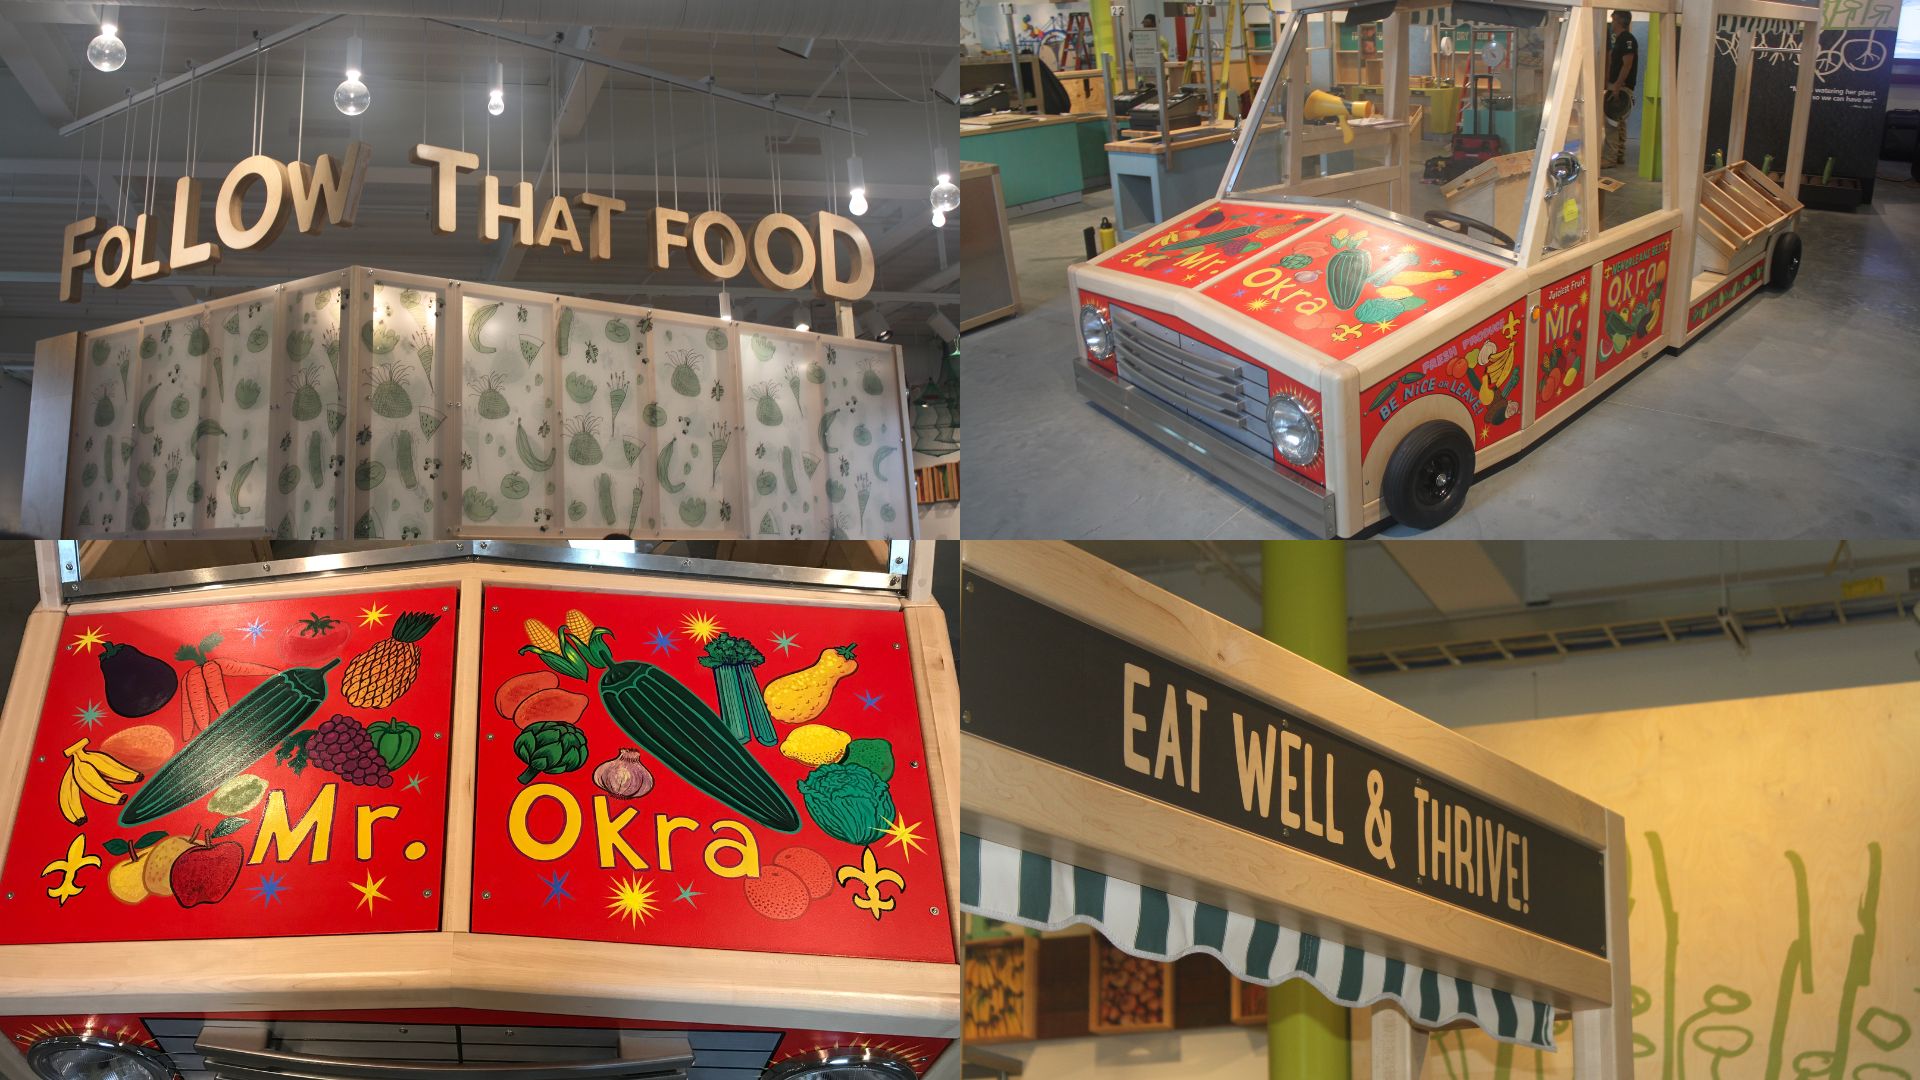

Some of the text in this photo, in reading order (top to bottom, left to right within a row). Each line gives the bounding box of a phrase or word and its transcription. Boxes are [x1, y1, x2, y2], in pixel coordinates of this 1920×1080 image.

[60, 141, 876, 303] FOLLOW THAT FOOD
[1172, 250, 1227, 275] Mr.
[1548, 275, 1586, 301] Juiciest Fruit
[1242, 266, 1328, 316] Okra
[1422, 317, 1505, 375] FRESH PRODUCE
[1545, 303, 1582, 345] Mr.
[1379, 396, 1399, 422] BE
[1450, 380, 1485, 416] LEAVE!
[1123, 662, 1530, 914] EAT WELL & THRIVE!
[248, 783, 427, 868] Mr.
[506, 781, 763, 880] Okra
